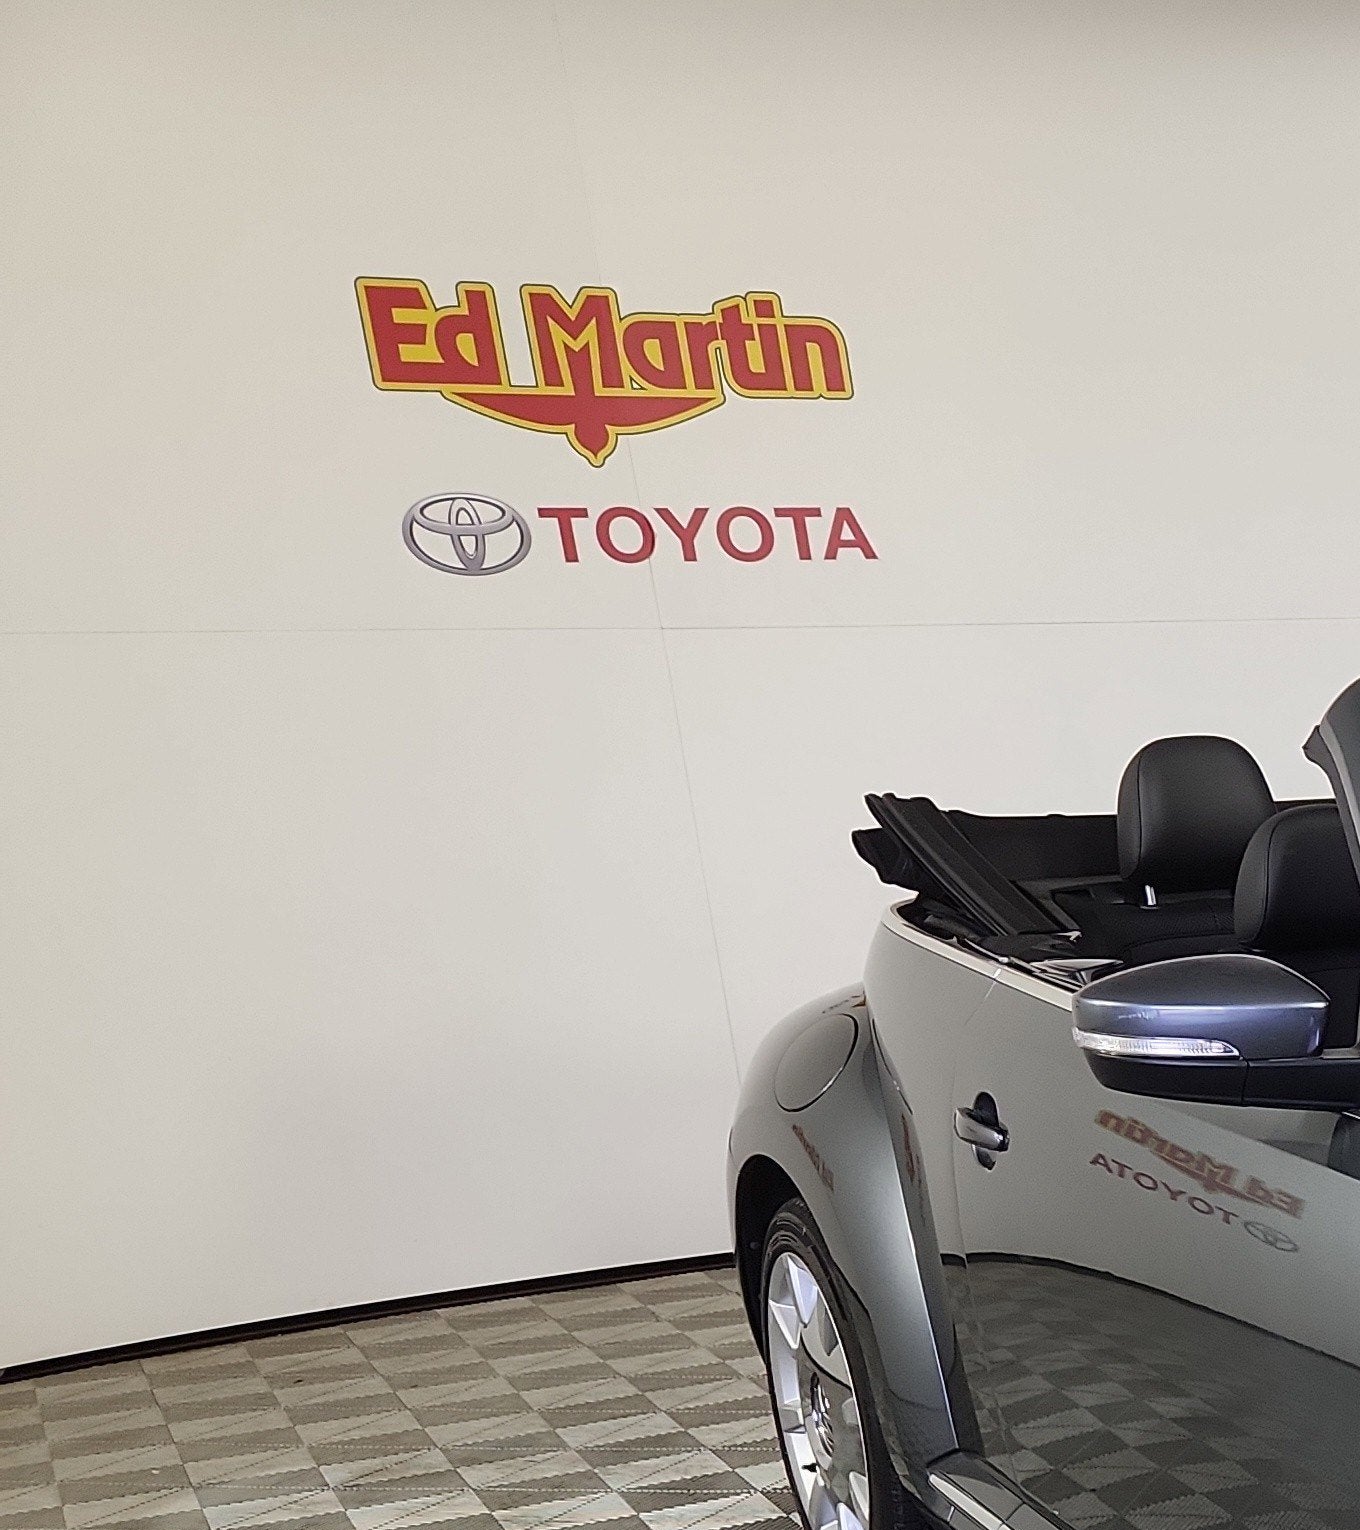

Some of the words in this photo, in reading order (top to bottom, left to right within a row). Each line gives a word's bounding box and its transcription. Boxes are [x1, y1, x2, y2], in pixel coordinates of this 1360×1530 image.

[356, 279, 507, 389] Ed
[522, 285, 852, 399] Martin
[537, 506, 878, 563] TOYOTA
